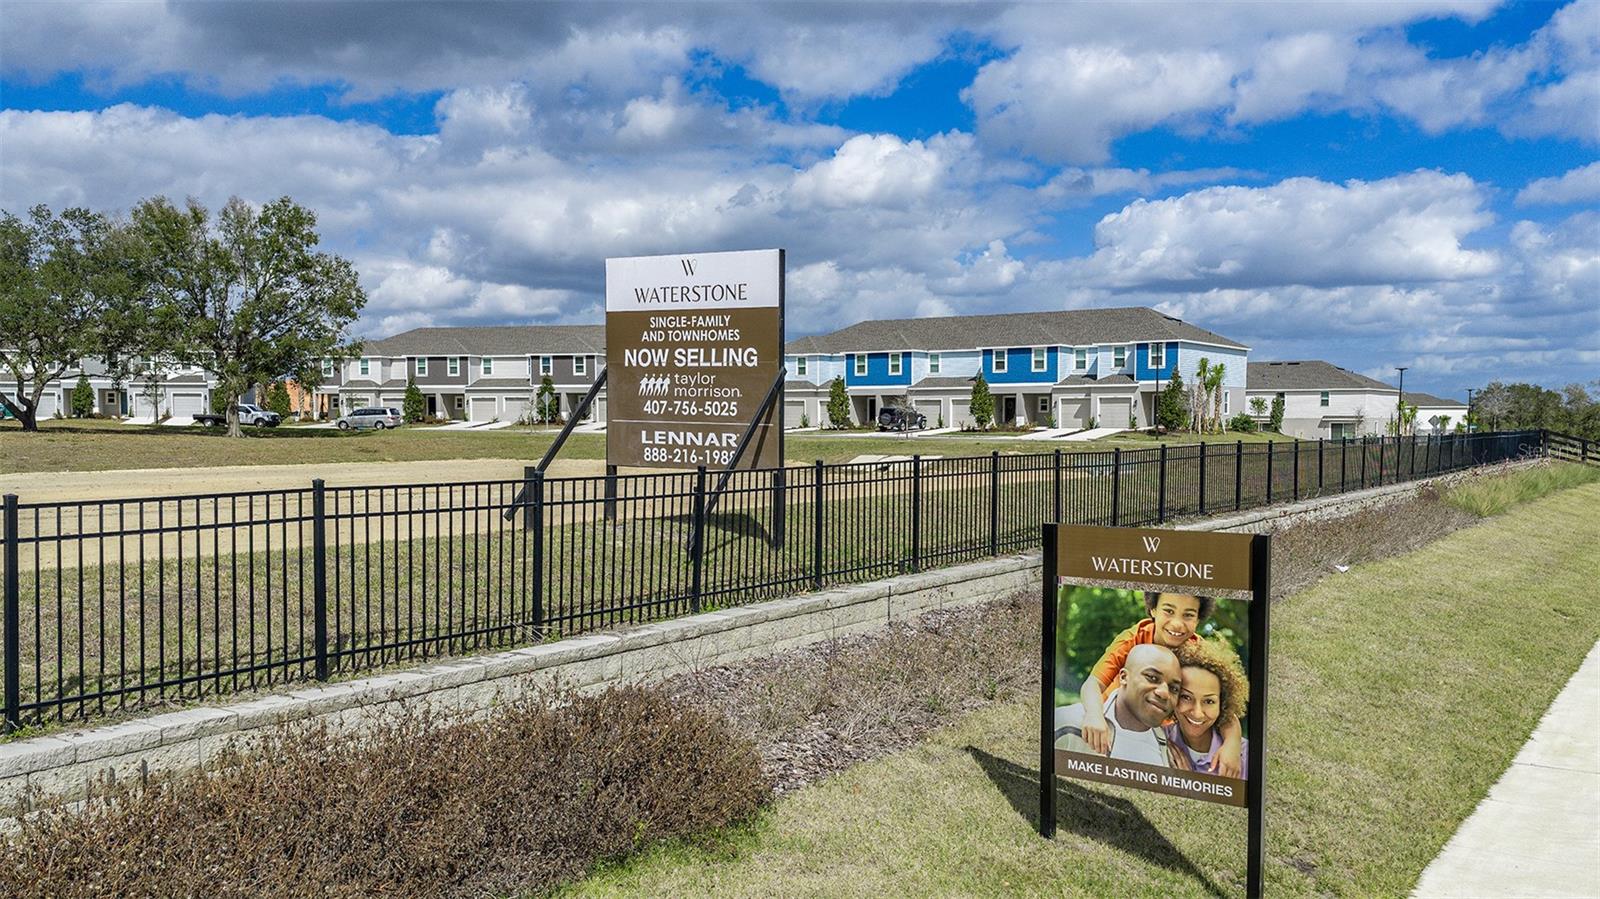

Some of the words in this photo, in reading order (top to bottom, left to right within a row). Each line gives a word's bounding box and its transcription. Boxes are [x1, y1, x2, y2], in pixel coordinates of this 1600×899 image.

[634, 283, 748, 304] WATERSTONE
[649, 315, 732, 328] SINGLE-FAMILY
[641, 330, 665, 342] AND
[668, 329, 741, 342] TOWNHOMES
[624, 348, 669, 367] NOW
[674, 347, 758, 368] SELLING
[674, 372, 716, 387] taylor
[643, 400, 738, 416] 407-756-5025
[641, 430, 738, 447] LENNAR
[1091, 556, 1214, 580] WATERSTONE
[1067, 759, 1102, 775] MAKE
[1105, 766, 1158, 784] LASTING
[1161, 775, 1233, 797] MEMORIES
